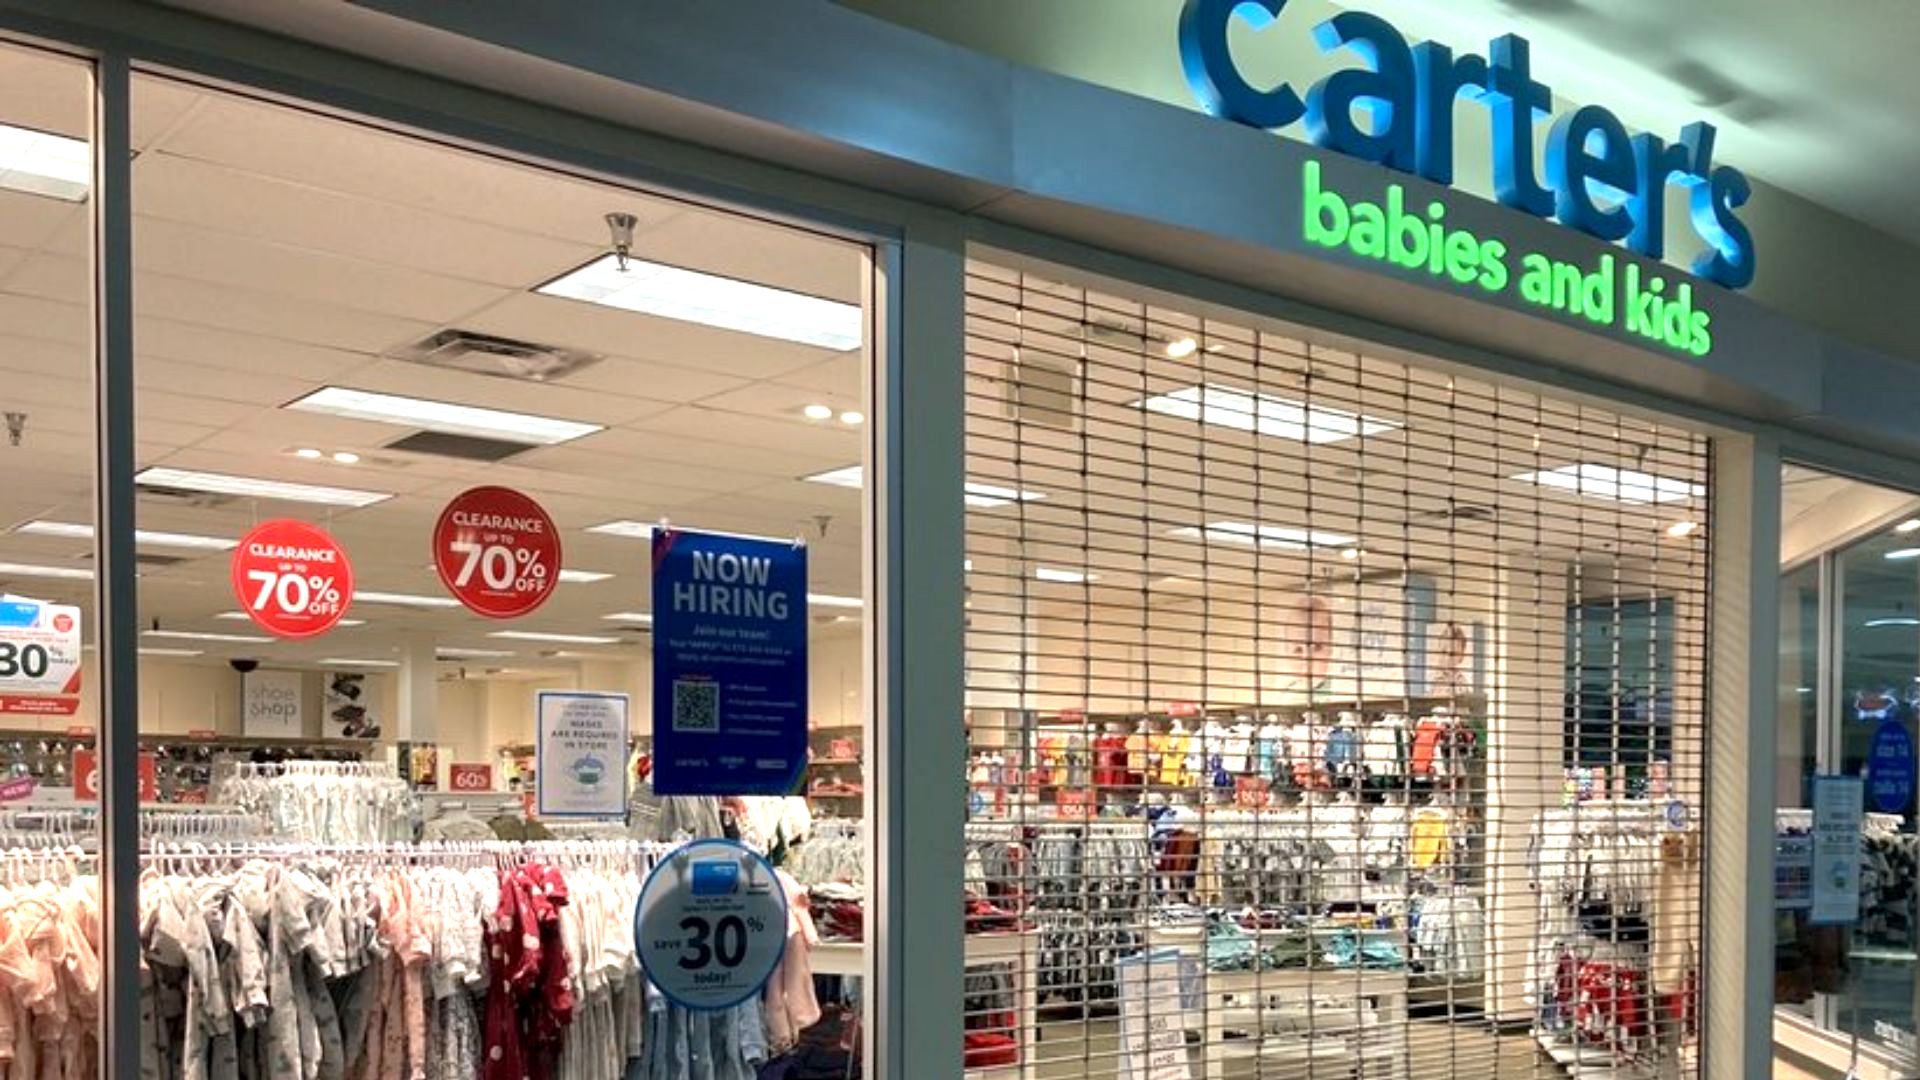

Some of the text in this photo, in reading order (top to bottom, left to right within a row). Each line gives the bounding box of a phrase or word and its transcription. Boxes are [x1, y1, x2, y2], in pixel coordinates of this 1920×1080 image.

[1178, 0, 1755, 289] carter's
[1302, 160, 1712, 356] babies and kids
[453, 511, 543, 534] CLEARANCE
[249, 543, 336, 563] CLEARANCE
[450, 541, 546, 590] 70%
[692, 550, 771, 587] NOW
[248, 569, 339, 614] 70%
[515, 578, 546, 593] OFF
[309, 601, 340, 616] OFF
[673, 580, 789, 620] HIRING
[251, 685, 297, 701] shoe
[250, 699, 298, 725] shop
[693, 971, 733, 984] today!
